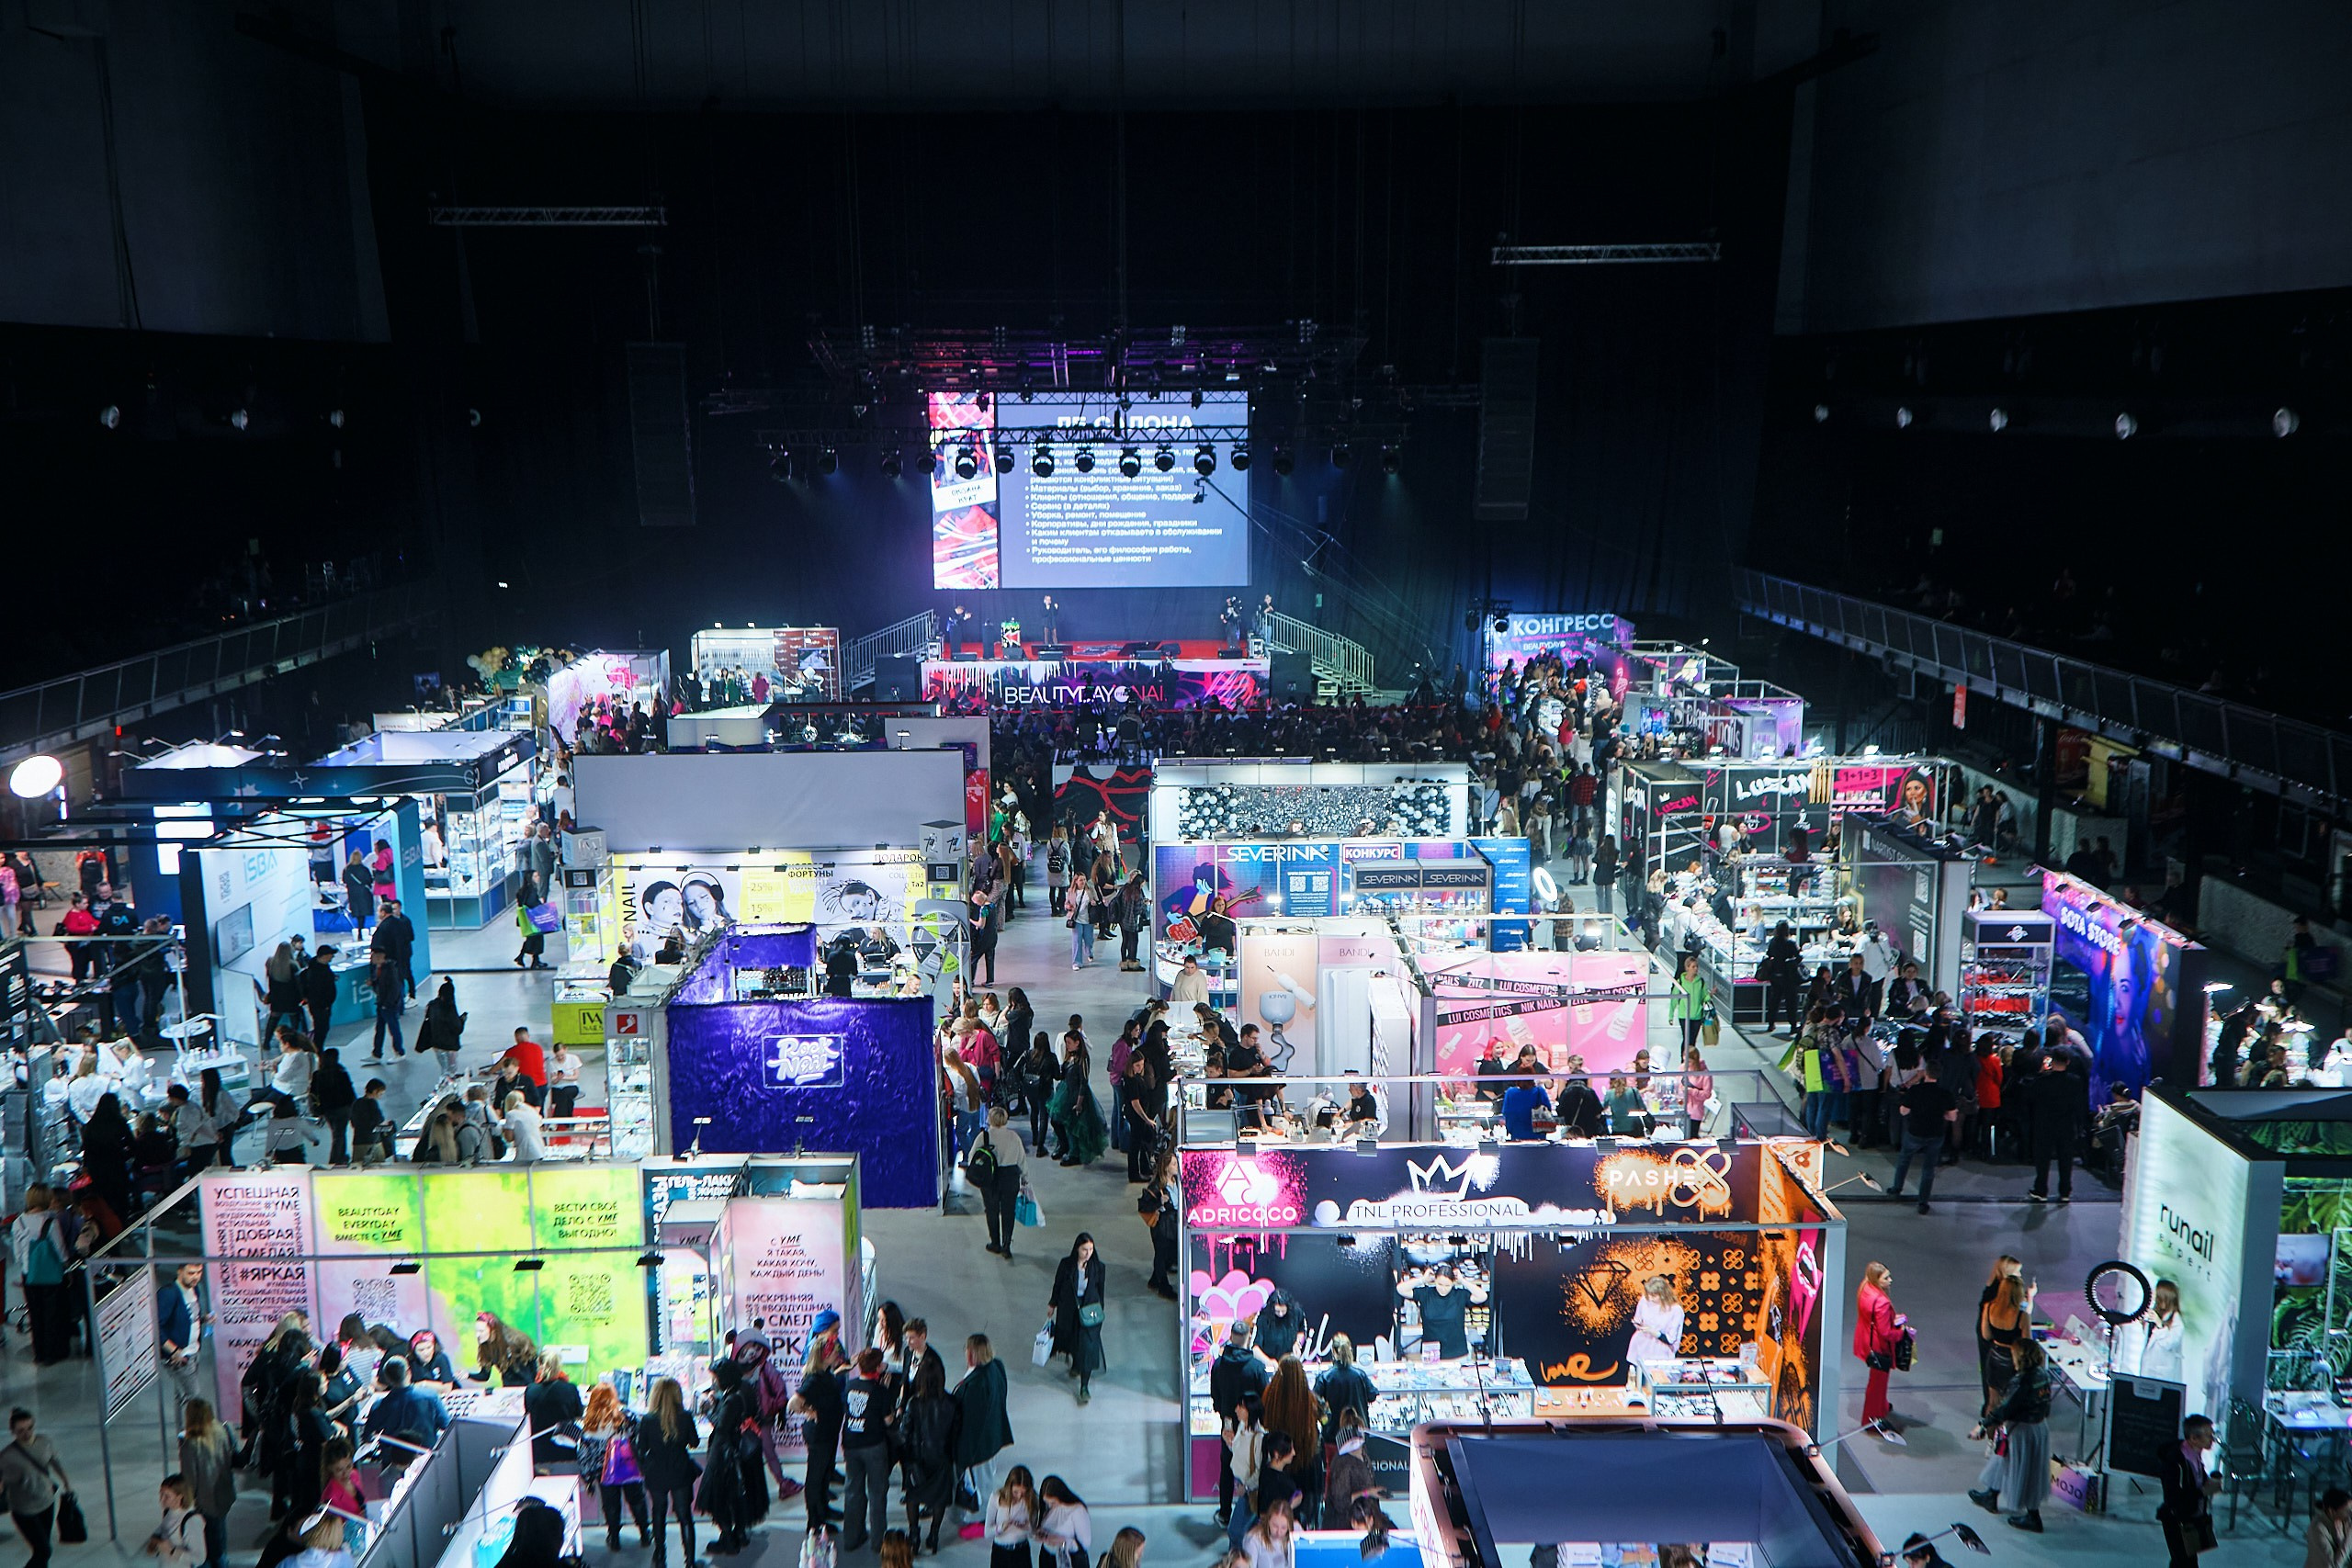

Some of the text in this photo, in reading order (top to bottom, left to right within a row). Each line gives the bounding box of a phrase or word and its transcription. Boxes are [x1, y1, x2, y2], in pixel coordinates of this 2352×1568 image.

[1031, 485, 1079, 493] Материалы
[1031, 493, 1068, 502] Клиенты
[1031, 502, 1062, 511] Сервис
[1031, 512, 1064, 520] Уборка,
[1065, 512, 1098, 520] ремонт,
[1031, 521, 1090, 529] Корпоративы,
[1107, 520, 1152, 529] рождения,
[1153, 520, 1198, 528] праздники
[1162, 528, 1223, 536] обслуживании
[1032, 547, 1092, 556] Руководитель,
[1109, 546, 1158, 555] философия
[1159, 546, 1192, 555] работы,
[1032, 556, 1112, 564] профессиональные
[1513, 614, 1615, 636] КОНГРЕСС
[1004, 685, 1115, 704] BEAUTYAY
[1218, 846, 1329, 863] SEVERINA
[1345, 848, 1398, 859] КОНКУРС
[1360, 874, 1417, 885] SEVERINA
[1425, 874, 1484, 884] SEVERINA
[622, 880, 637, 922] NAIL
[2061, 906, 2121, 956] SOTA STORE
[1264, 948, 1295, 957] BANDI
[1340, 948, 1371, 957] BANDI
[1467, 978, 1485, 988] ZITZ
[1499, 981, 1513, 991] LUI
[1514, 982, 1559, 995] COSMETICS
[1448, 1012, 1462, 1024] LUI
[1464, 1006, 1512, 1021] COSMETICS
[1521, 1002, 1536, 1013] NIK
[1537, 999, 1561, 1010] NAILS
[582, 1012, 604, 1025] IVA
[776, 1037, 840, 1060] Rock
[668, 1175, 737, 1188] ГЕЛЬ-ЛАКИ
[1610, 1169, 1696, 1187] PASHE
[214, 1187, 300, 1199] УСПЕШНАЯ
[696, 1187, 733, 1196] ЖИДКИ
[338, 1208, 400, 1217] BEAUTYDAY
[554, 1203, 587, 1213] ВЕСТИ
[1355, 1202, 1523, 1218] TNL PROFESSIONAL
[1188, 1206, 1297, 1223] ADRICOCO
[344, 1220, 395, 1229] EVERYDAY
[553, 1216, 584, 1227] ДЕЛО
[588, 1216, 594, 1224] С
[235, 1229, 294, 1242] ДОБРАЯ
[372, 1233, 379, 1241] С
[559, 1229, 617, 1238] ВЫГОДНО!
[2160, 1203, 2214, 1263] runail
[237, 1247, 294, 1258] СМЕЛАЯ
[776, 1249, 807, 1258] ТАКАЯ,
[2159, 1234, 2211, 1282] expert
[790, 1258, 817, 1268] ХОЧУ,
[240, 1267, 305, 1281] #ЯРКАЯ
[750, 1269, 825, 1279] КАЖДЫЙ ДЕНЬ!
[222, 1296, 308, 1304] ВОСХИТИТЕЛЬНАЯ
[746, 1293, 814, 1303] #ИСКРЕННЯЯ
[762, 1303, 832, 1314] #ВОЗДУШНАЯ
[223, 1314, 282, 1324] БОЖЕСТВЕ
[769, 1314, 812, 1327] СМЕЛ
[2051, 1474, 2083, 1500] MOJO
